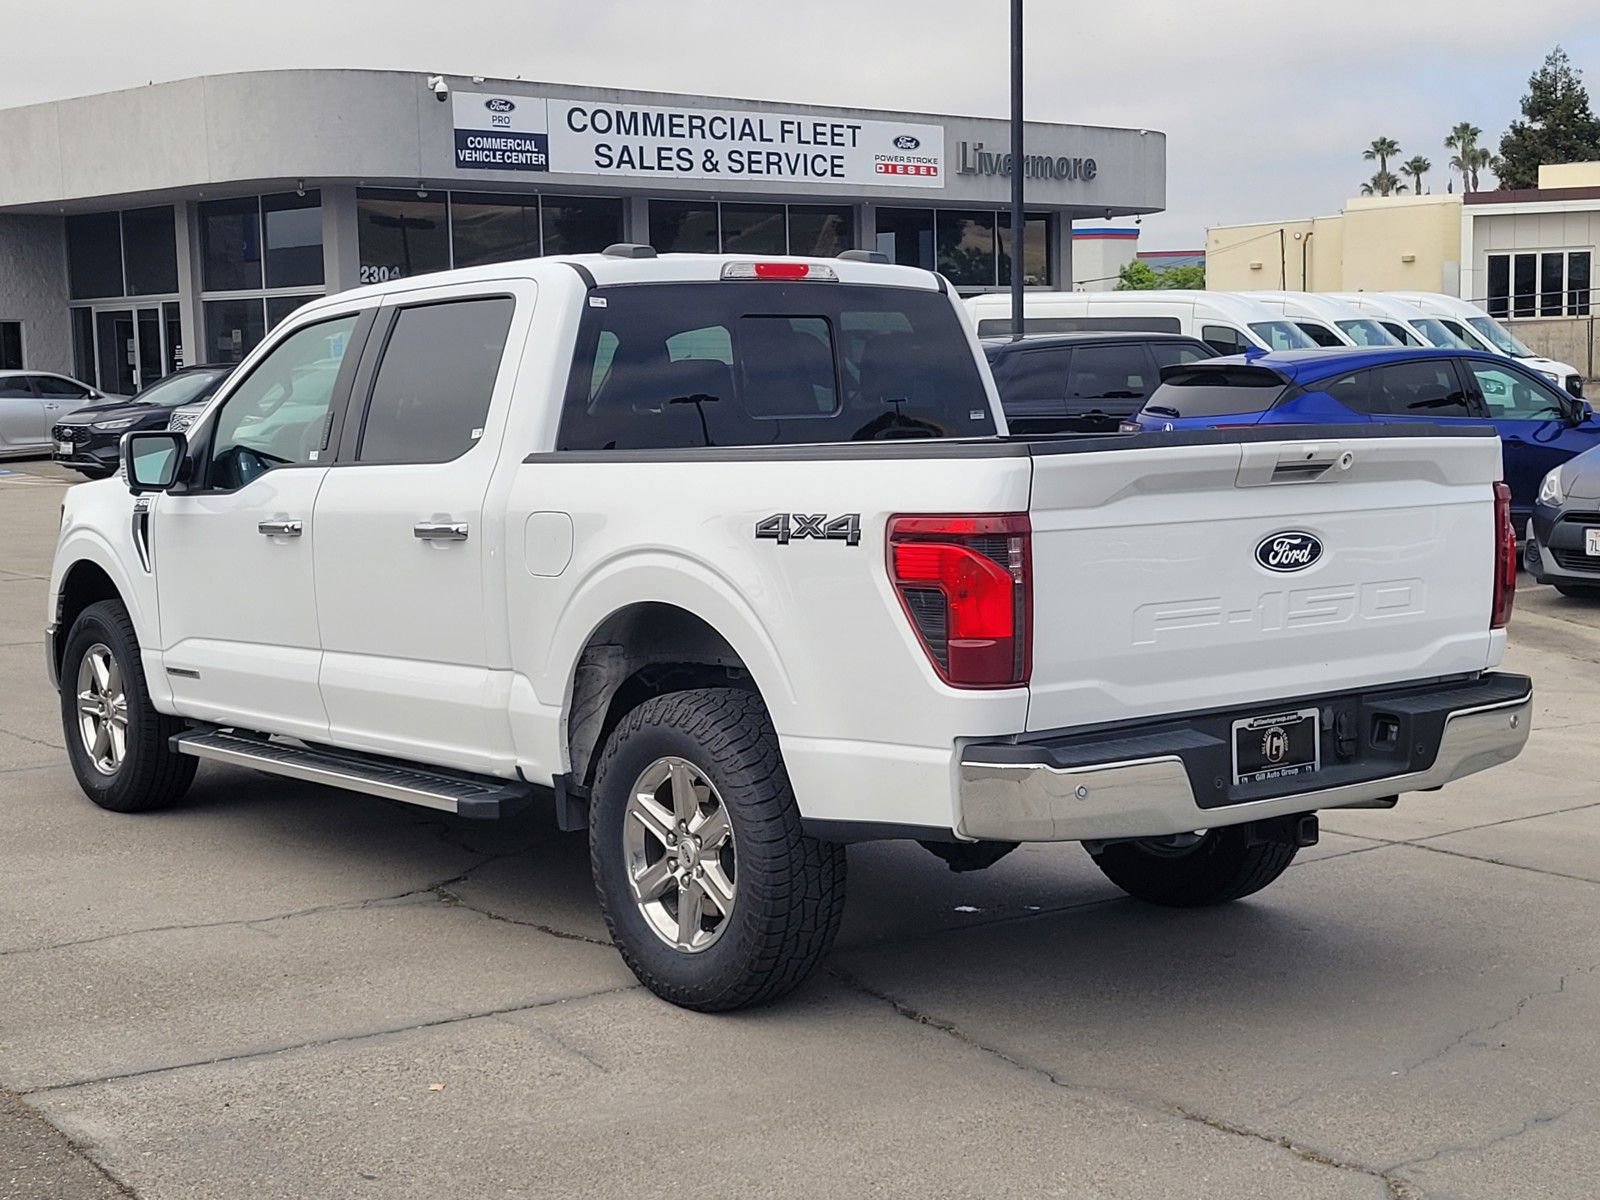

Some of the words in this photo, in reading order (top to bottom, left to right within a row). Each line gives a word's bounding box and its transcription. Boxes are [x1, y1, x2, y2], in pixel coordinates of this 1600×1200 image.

[489, 99, 510, 112] Ford
[491, 115, 511, 125] PRO
[567, 106, 774, 144] COMMERCIAL
[780, 120, 862, 148] FLEET
[467, 136, 538, 152] COMMERCIAL
[897, 136, 916, 149] Ford
[457, 149, 503, 162] VEHICLE
[504, 152, 546, 165] CENTER
[594, 143, 694, 172] SALES
[701, 149, 721, 174] &
[727, 150, 845, 178] SERVICE
[876, 164, 937, 176] DIESEL
[360, 265, 401, 283] 2304
[1268, 537, 1311, 565] Ford
[1132, 577, 1425, 645] F-150
[1255, 773, 1265, 781] Gill
[1266, 771, 1280, 779] Auto
[1281, 768, 1299, 777] Group
